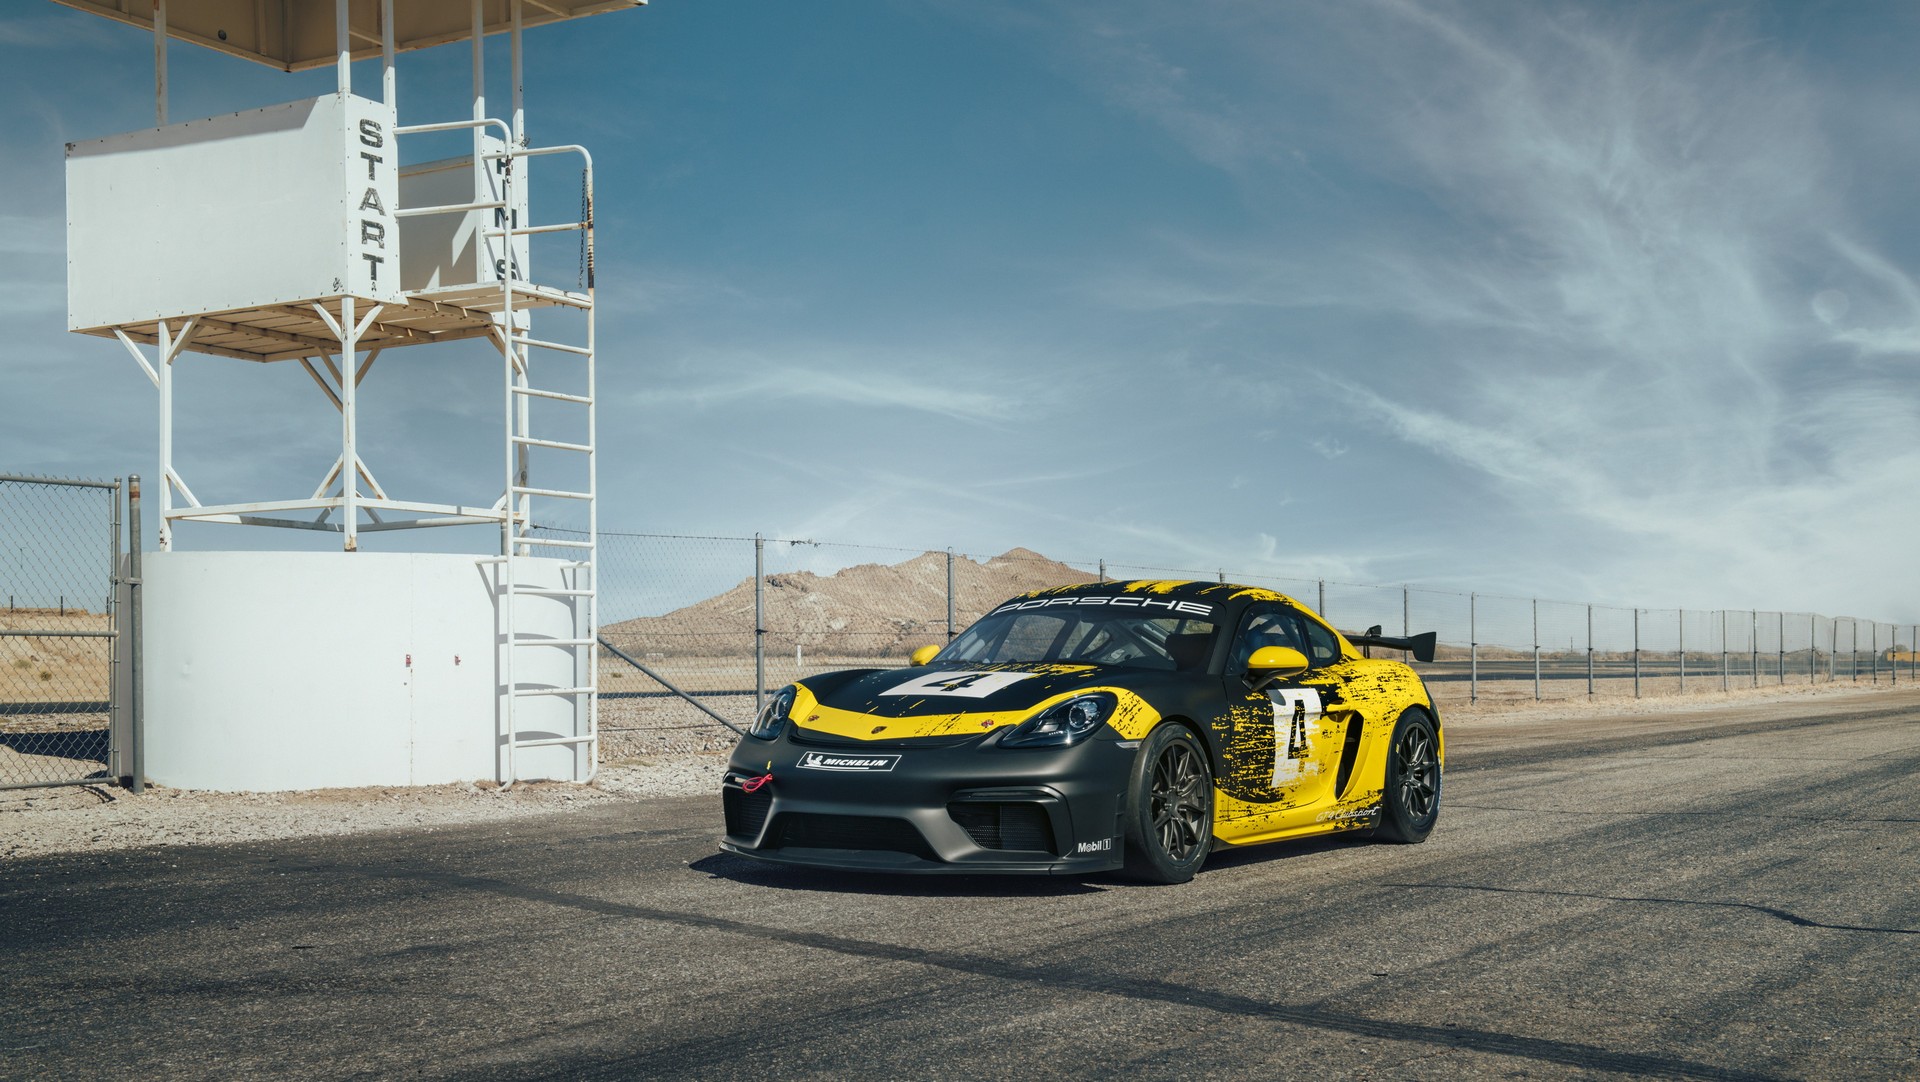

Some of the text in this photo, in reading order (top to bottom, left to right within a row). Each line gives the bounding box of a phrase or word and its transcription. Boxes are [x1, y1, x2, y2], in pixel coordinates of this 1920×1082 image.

[358, 118, 386, 281] START
[991, 596, 1213, 616] PORSCHE
[921, 673, 993, 692] 4
[1288, 699, 1309, 773] 4
[823, 758, 889, 767] MICHELIN
[1077, 840, 1102, 853] Mobil
